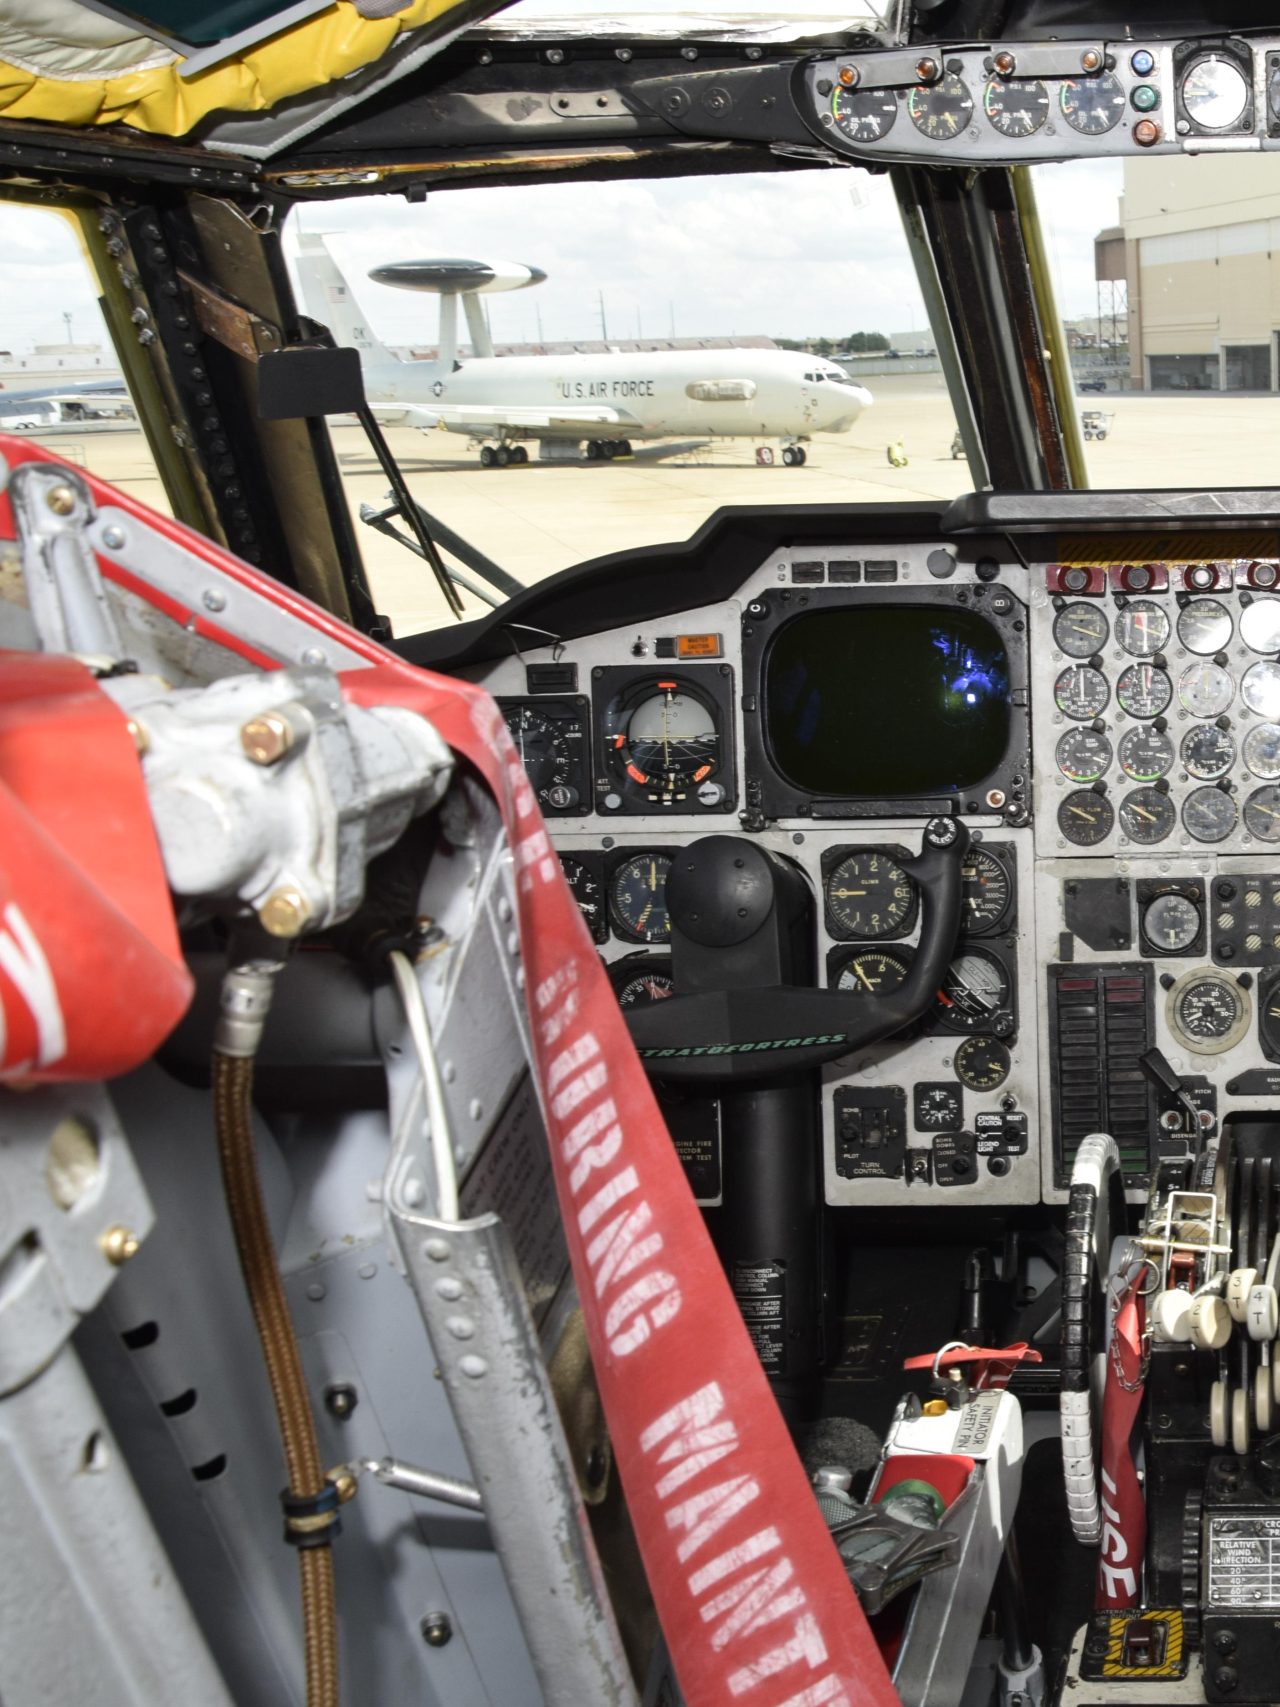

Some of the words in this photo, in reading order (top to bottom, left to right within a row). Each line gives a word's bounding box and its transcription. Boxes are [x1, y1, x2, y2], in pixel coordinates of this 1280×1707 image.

[589, 382, 607, 397] AIR
[613, 380, 654, 397] FORCE
[930, 834, 952, 845] SELECT
[870, 862, 878, 871] 2
[889, 871, 897, 880] 4
[894, 888, 903, 897] 6
[888, 903, 897, 912] 4
[872, 915, 879, 924] 2
[537, 957, 682, 1356] DURING
[1232, 1277, 1241, 1287] 3
[1253, 1291, 1263, 1301] 4
[1253, 1312, 1263, 1325] T
[962, 1404, 981, 1432] SAFETY
[972, 1405, 993, 1445] INITIATOR
[957, 1434, 971, 1448] PIN
[1220, 1541, 1256, 1549] RELATIVE
[1228, 1549, 1251, 1557] WIND
[1219, 1556, 1261, 1564] IRECTION
